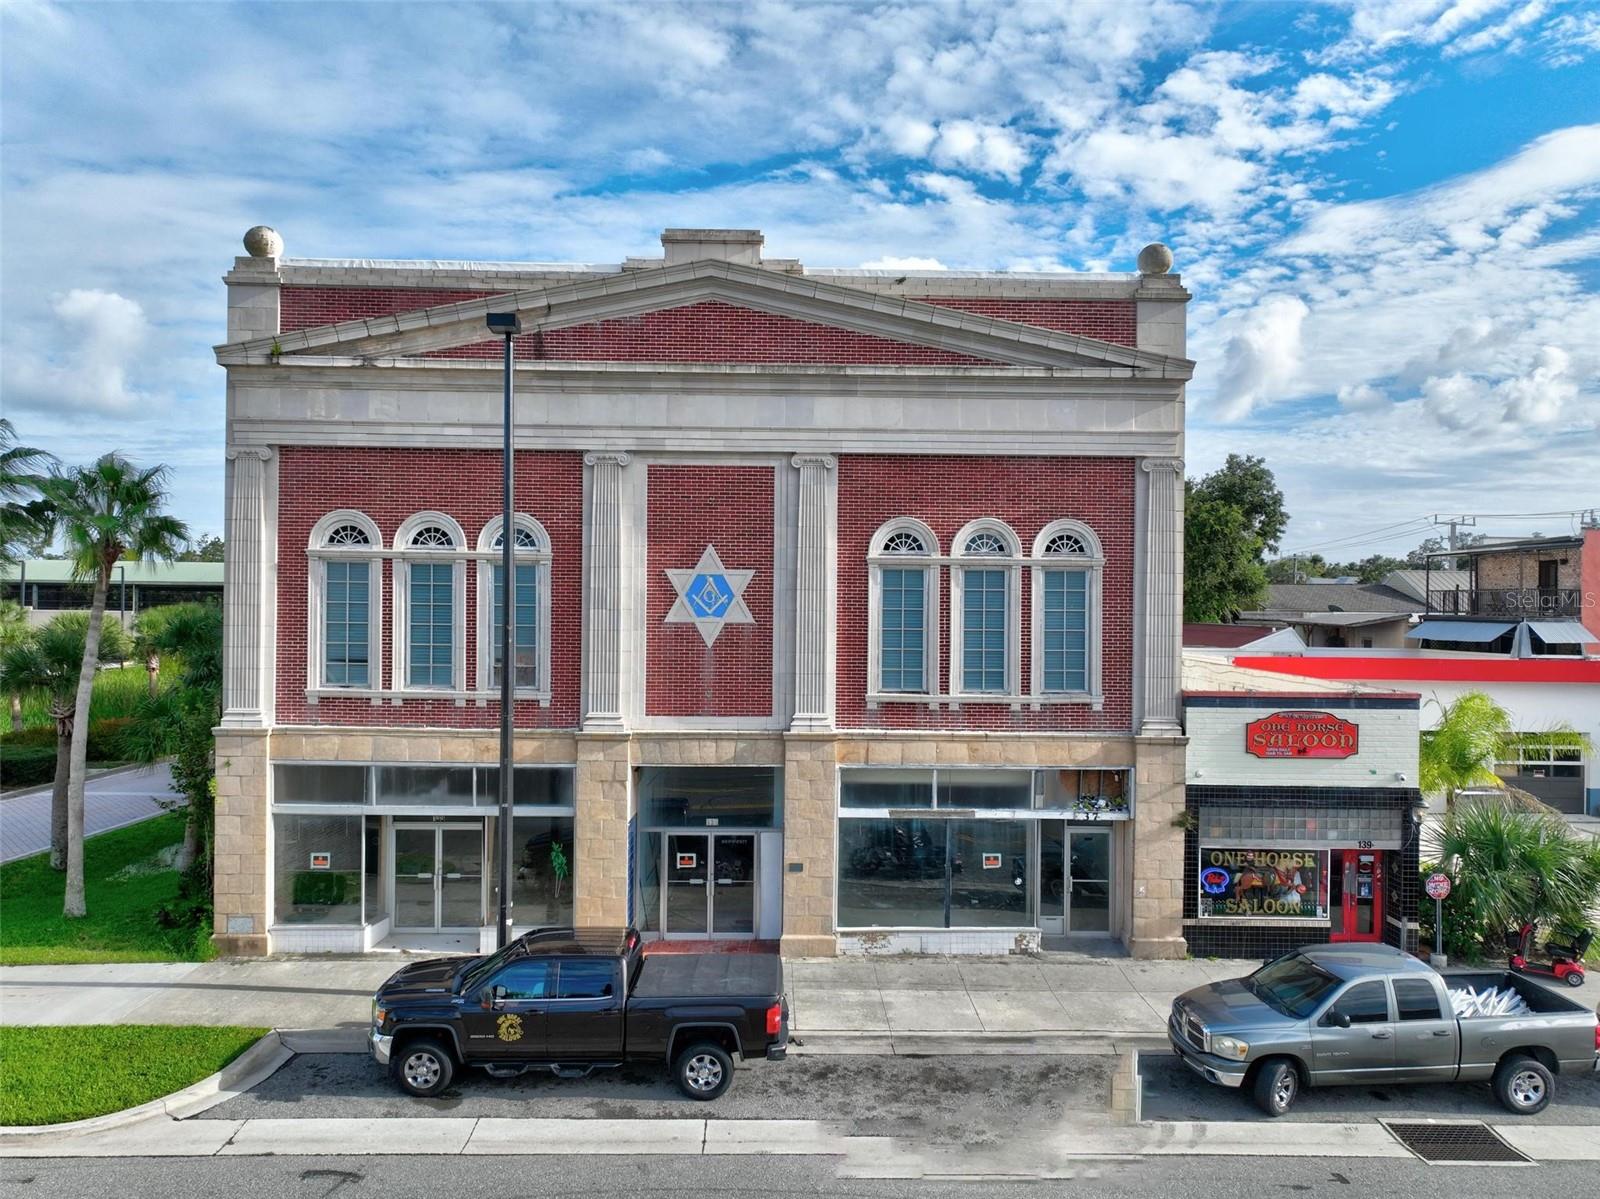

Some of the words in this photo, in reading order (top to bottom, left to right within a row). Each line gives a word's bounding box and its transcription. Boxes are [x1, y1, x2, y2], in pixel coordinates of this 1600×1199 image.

[1261, 722, 1290, 732] ONE
[1297, 722, 1344, 734] HORSE
[1253, 732, 1354, 749] SALOON
[1210, 851, 1248, 867] ONE
[1254, 852, 1316, 868] HORSE
[1225, 898, 1301, 914] SALOON
